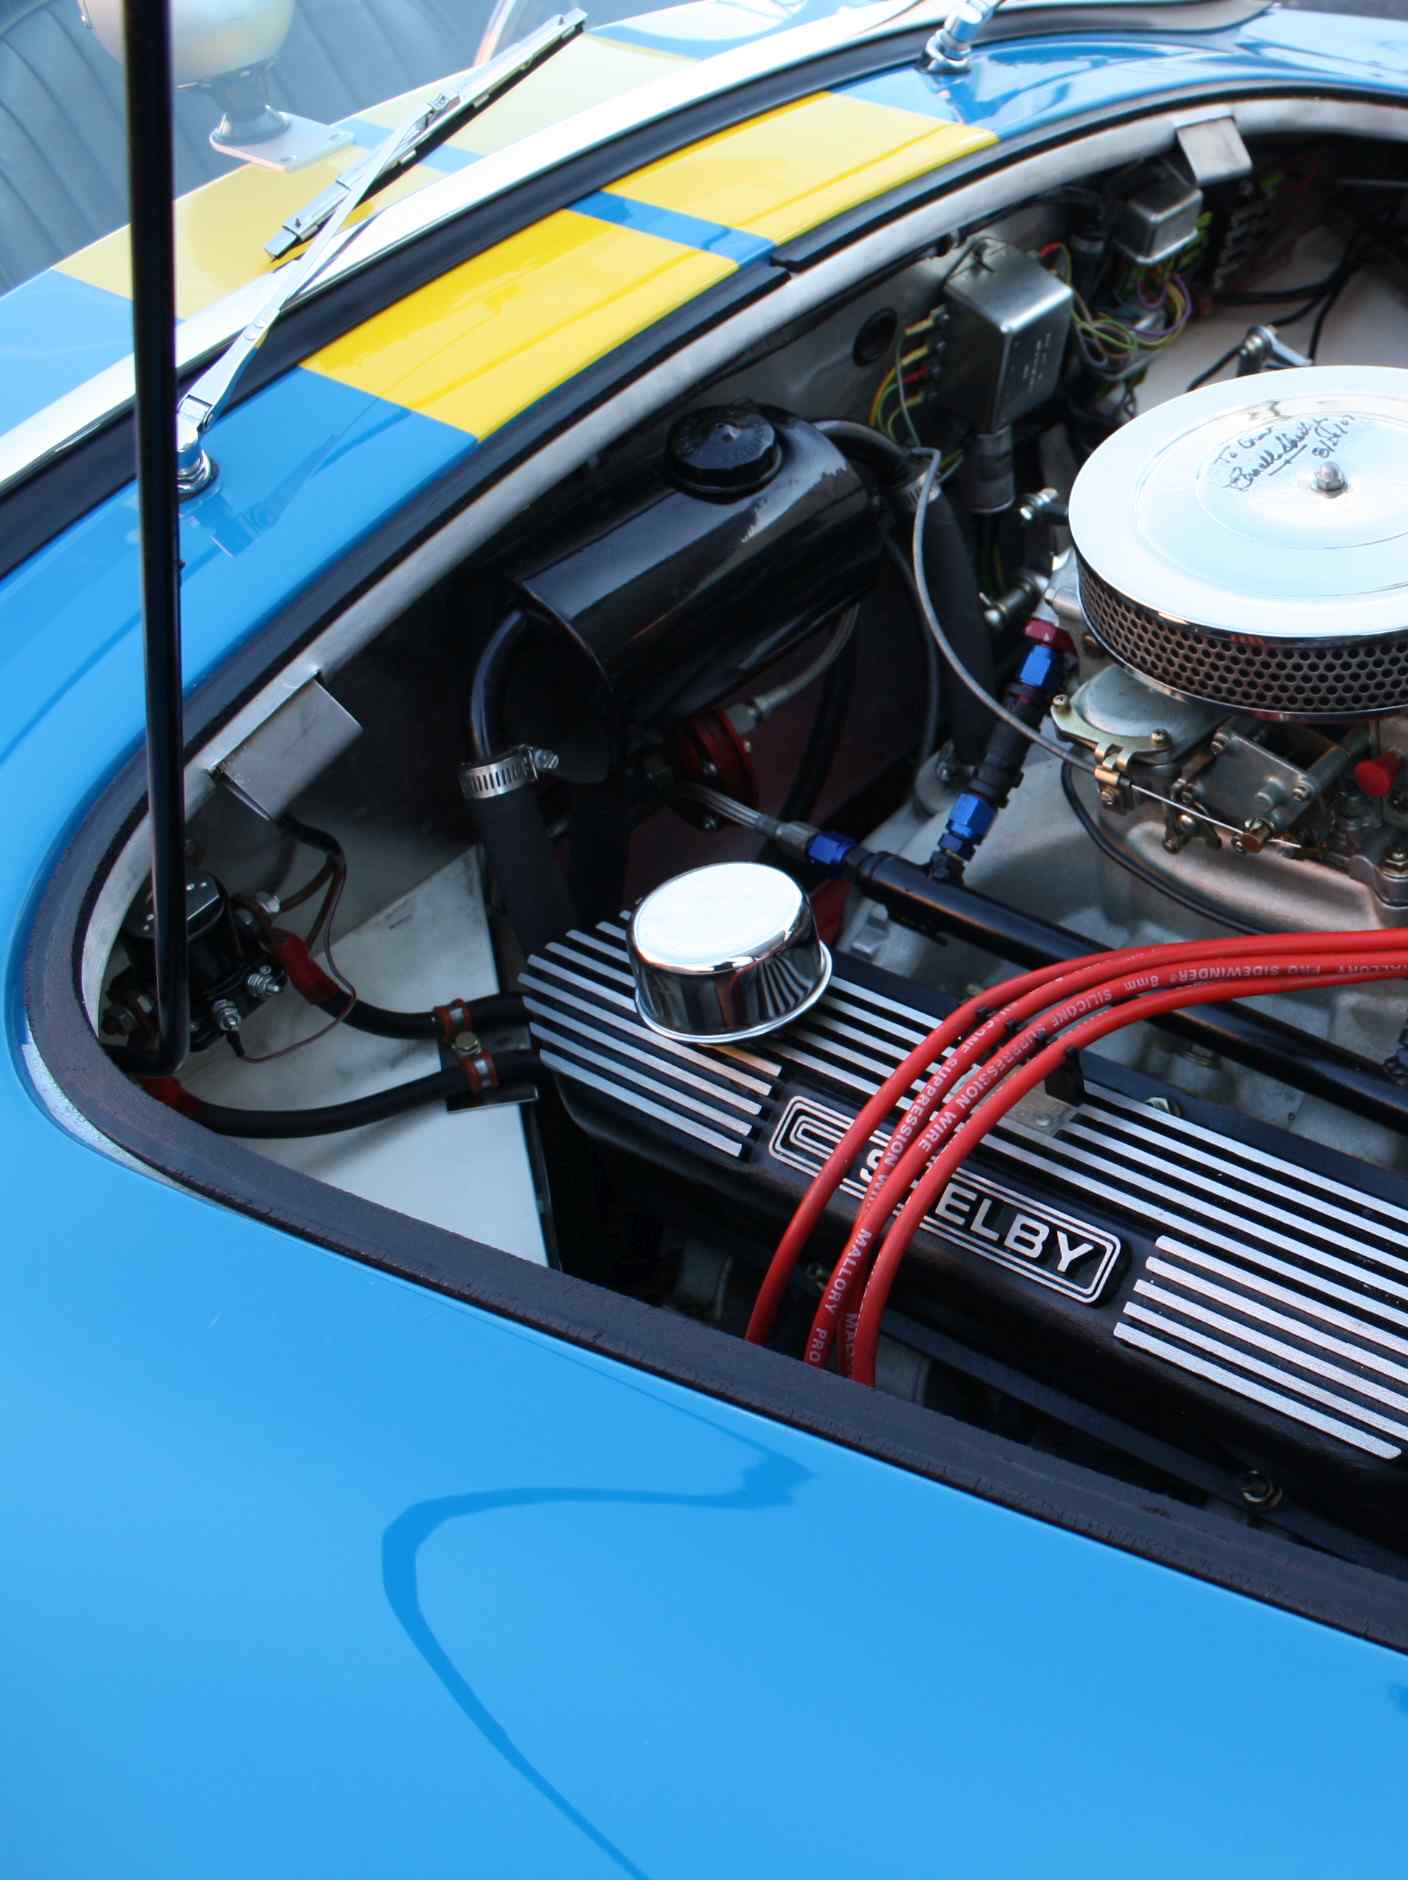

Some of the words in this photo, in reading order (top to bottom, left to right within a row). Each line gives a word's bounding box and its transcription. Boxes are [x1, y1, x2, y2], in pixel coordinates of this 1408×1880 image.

[1123, 974, 1160, 991] 8mm
[1051, 987, 1113, 1027] SILICONE
[918, 1111, 957, 1152] WIRE
[823, 1228, 873, 1314] MALLORY
[808, 1327, 829, 1362] PRO
